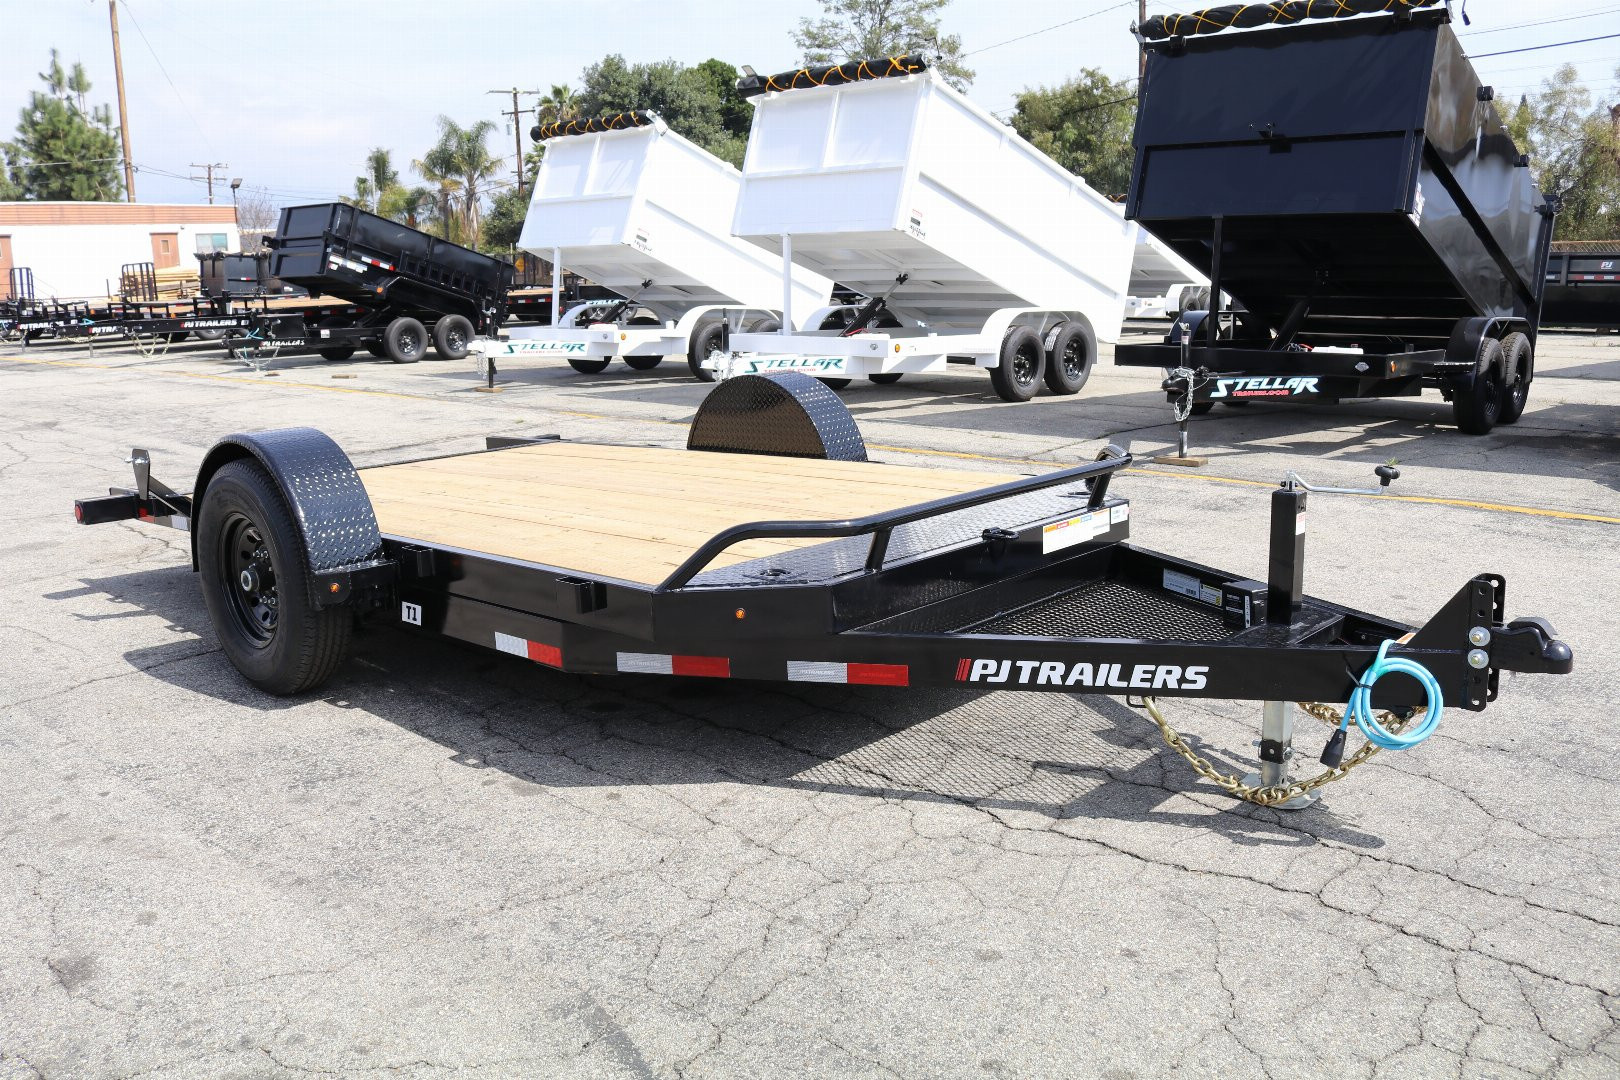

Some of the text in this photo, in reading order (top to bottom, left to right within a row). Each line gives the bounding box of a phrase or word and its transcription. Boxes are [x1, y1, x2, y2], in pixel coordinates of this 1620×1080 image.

[195, 319, 238, 328] TRAILERS
[503, 343, 586, 354] STELLAR
[744, 358, 844, 374] STELLAR
[1210, 377, 1320, 398] STELLAR
[405, 605, 418, 622] T1
[969, 658, 1210, 690] PJ TRAILERS
